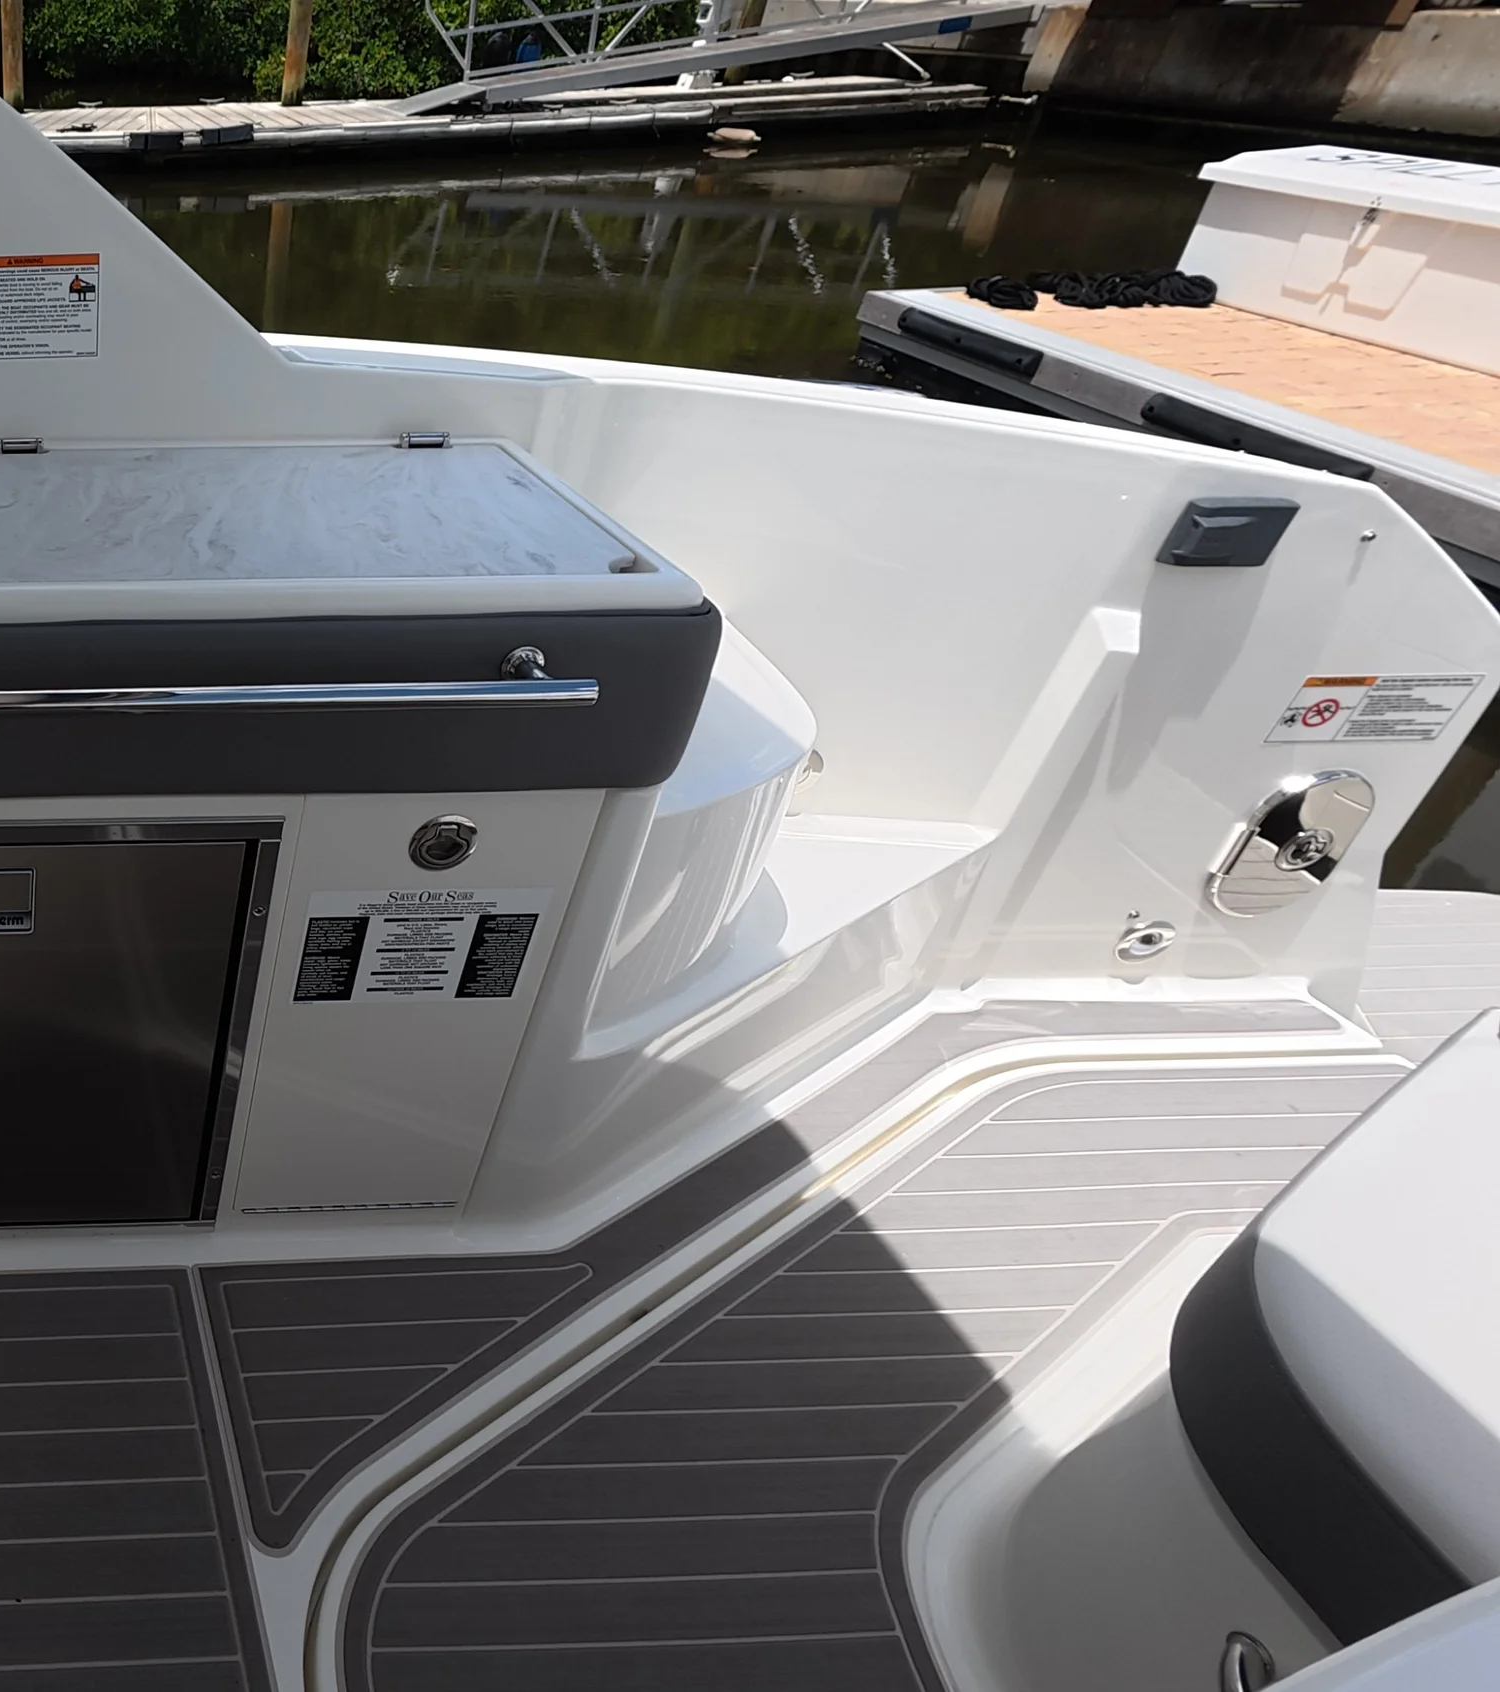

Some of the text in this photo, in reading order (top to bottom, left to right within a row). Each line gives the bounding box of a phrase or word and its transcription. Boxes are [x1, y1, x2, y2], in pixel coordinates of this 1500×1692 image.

[387, 890, 474, 903] Save Our Seas
